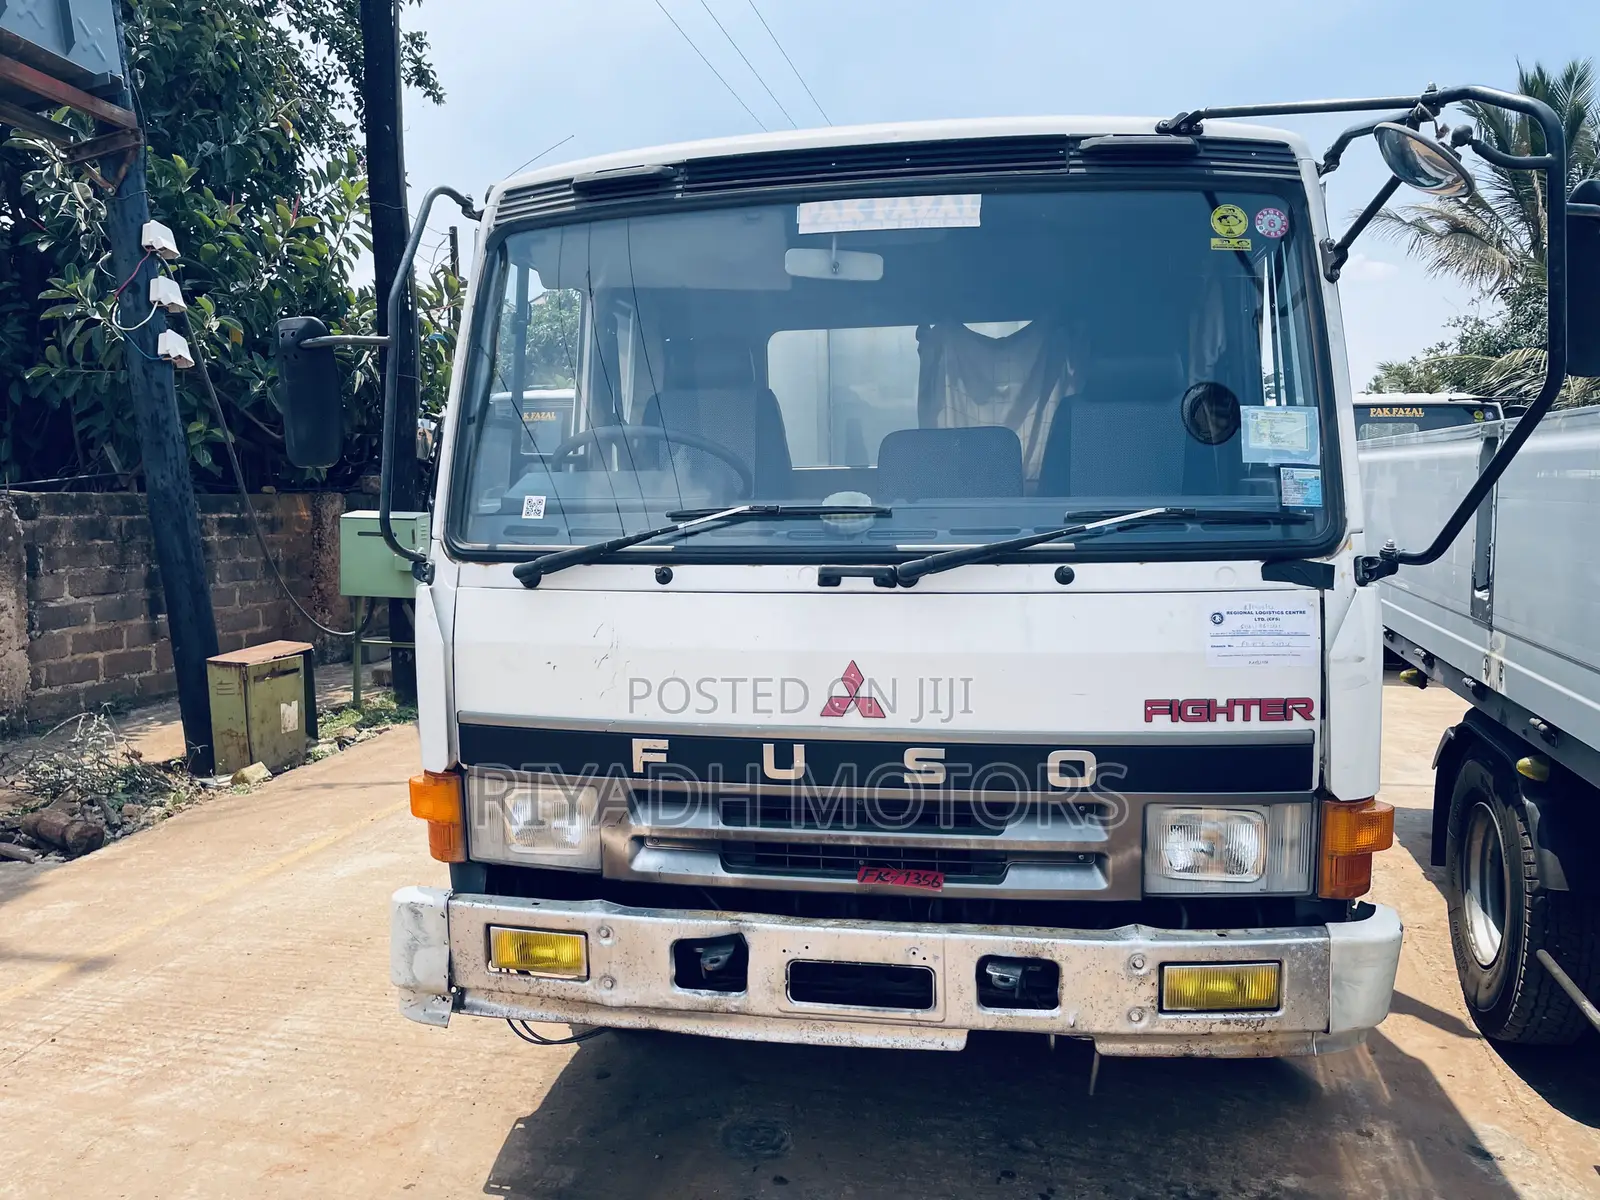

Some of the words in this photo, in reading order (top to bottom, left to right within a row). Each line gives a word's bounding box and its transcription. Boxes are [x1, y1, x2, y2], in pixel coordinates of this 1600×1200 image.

[531, 411, 556, 419] FAZAL
[1370, 407, 1391, 416] PAK
[1392, 407, 1424, 416] FAZAL
[1144, 697, 1315, 722] FIGHTER
[631, 738, 1097, 788] FUSO
